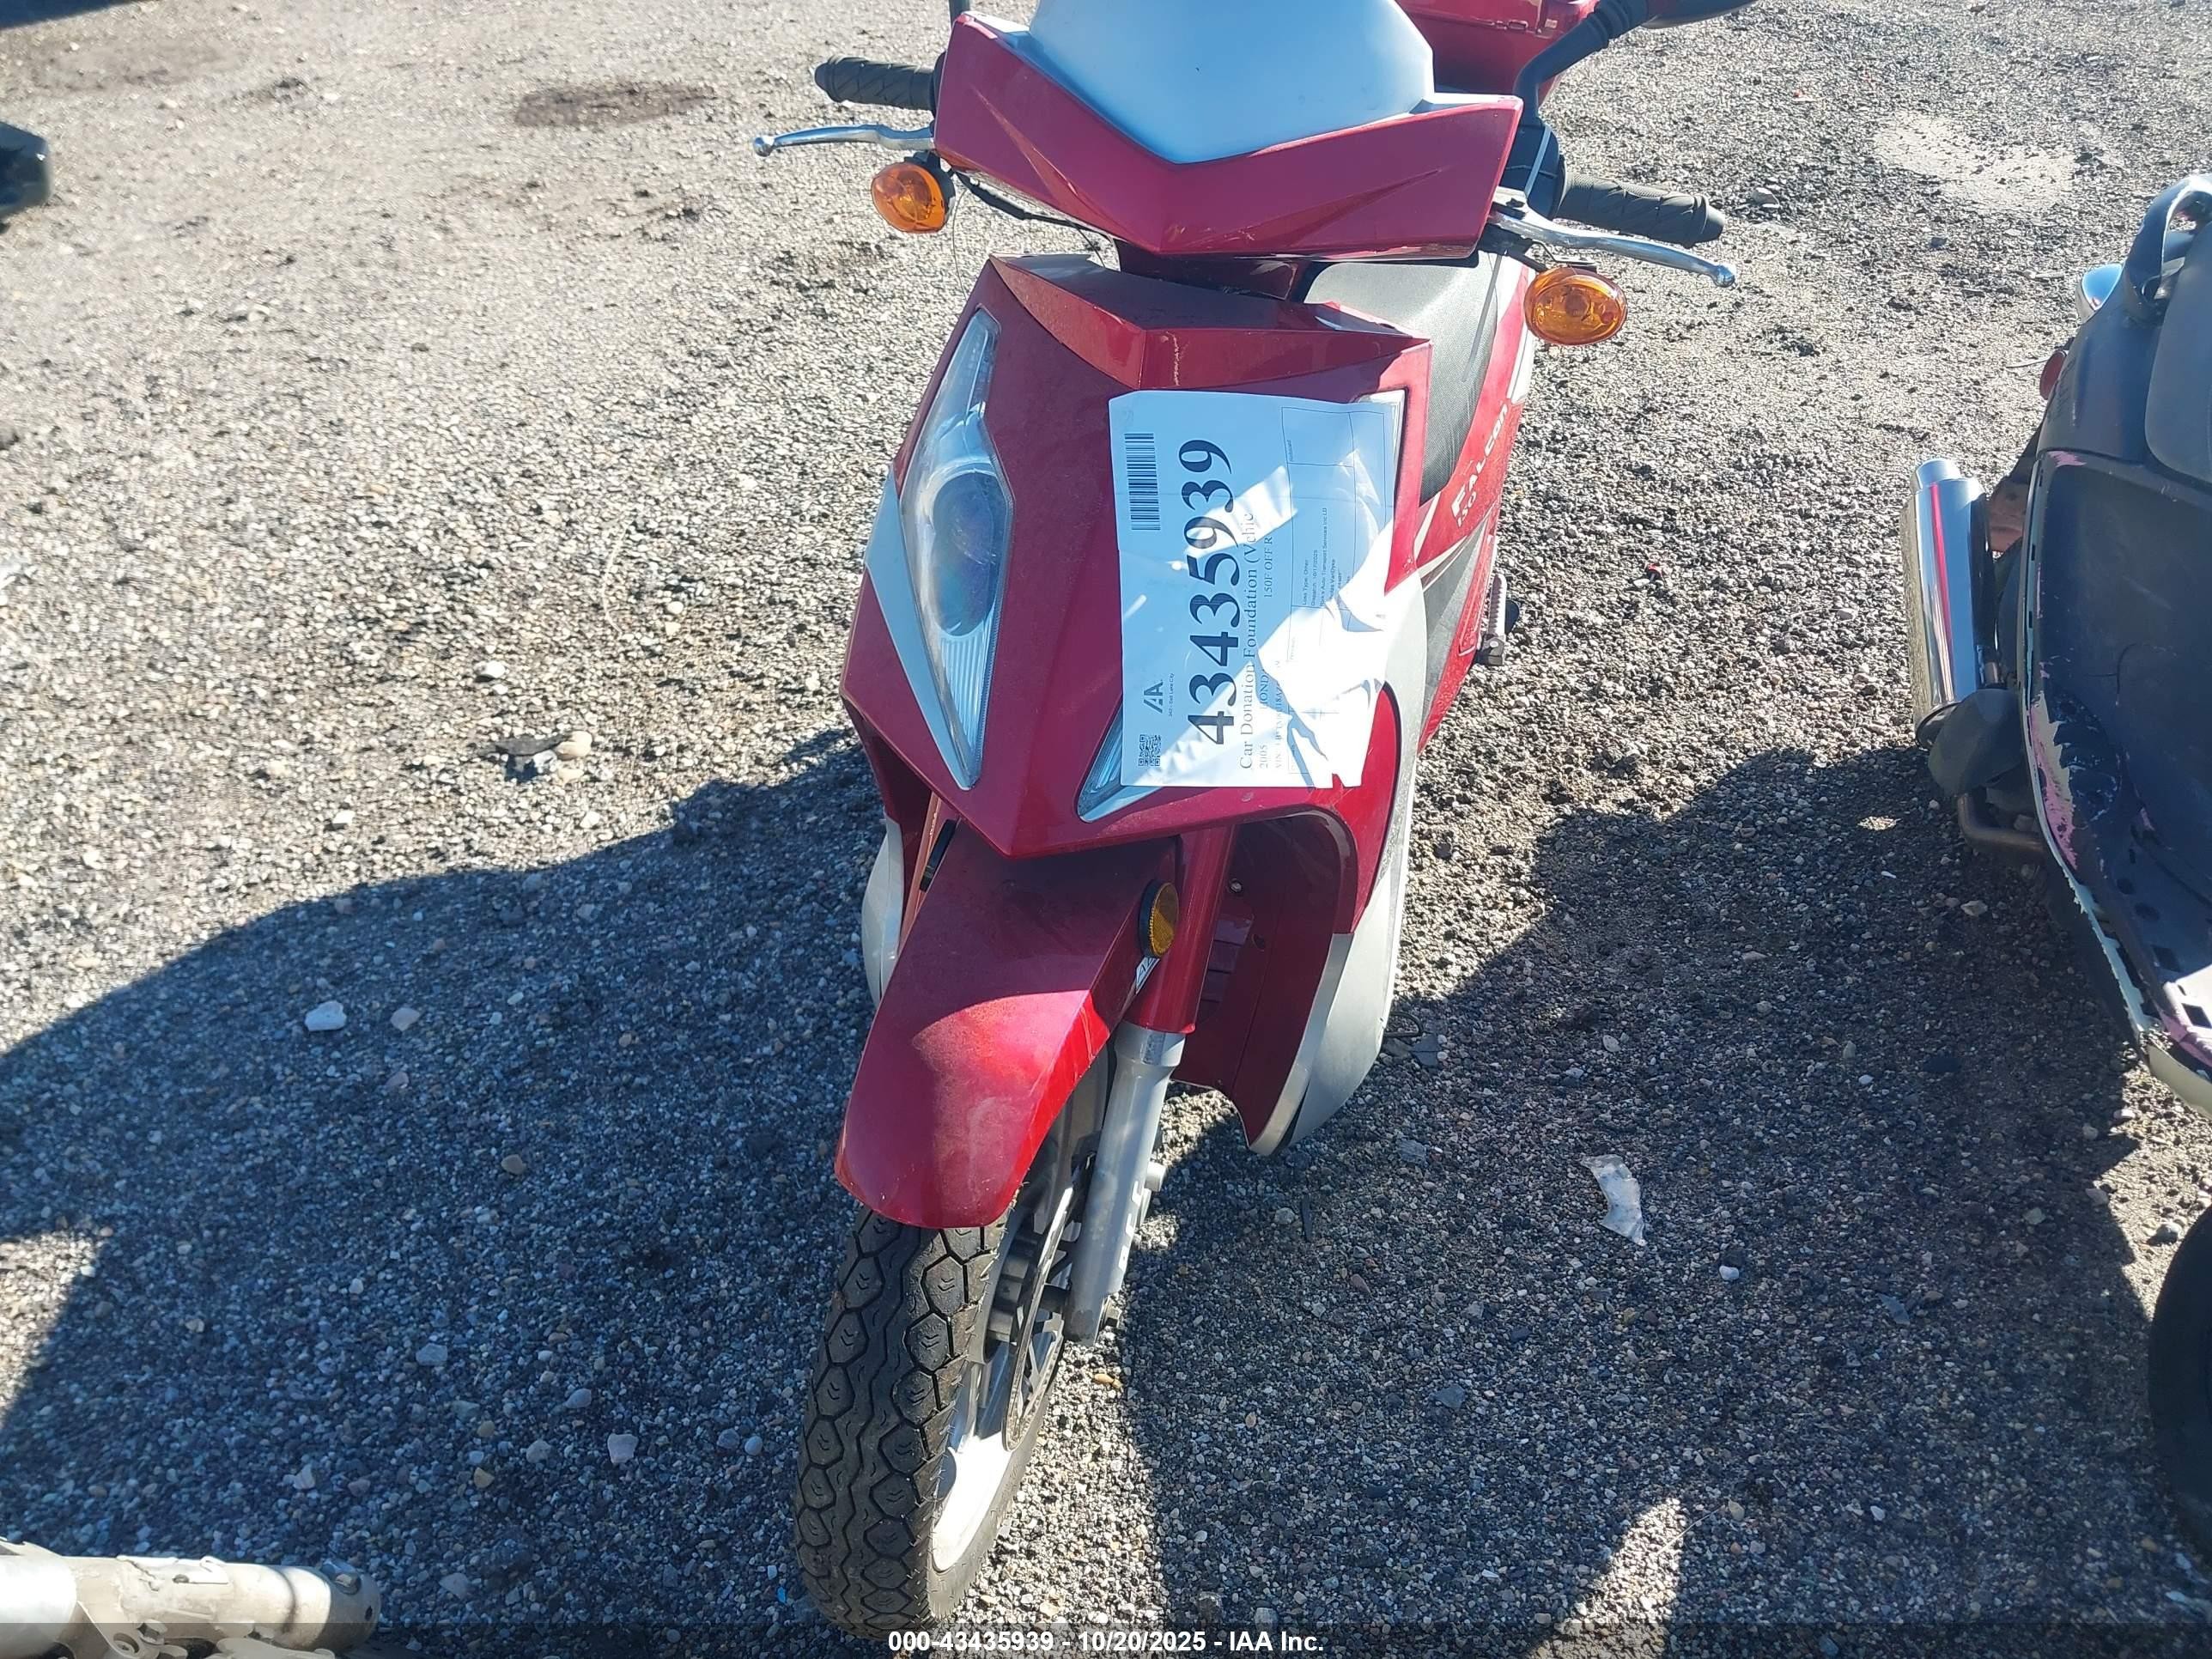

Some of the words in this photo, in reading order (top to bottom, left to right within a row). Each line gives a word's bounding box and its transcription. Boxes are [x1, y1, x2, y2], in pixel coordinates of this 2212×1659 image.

[1241, 513, 1261, 563] (Vehic
[1178, 439, 1240, 744] 43435939
[1243, 569, 1257, 658] Foundation
[1240, 665, 1254, 735] Donation
[1260, 674, 1268, 708] HOND
[1240, 741, 1254, 769] Car
[1259, 744, 1268, 769] 2005
